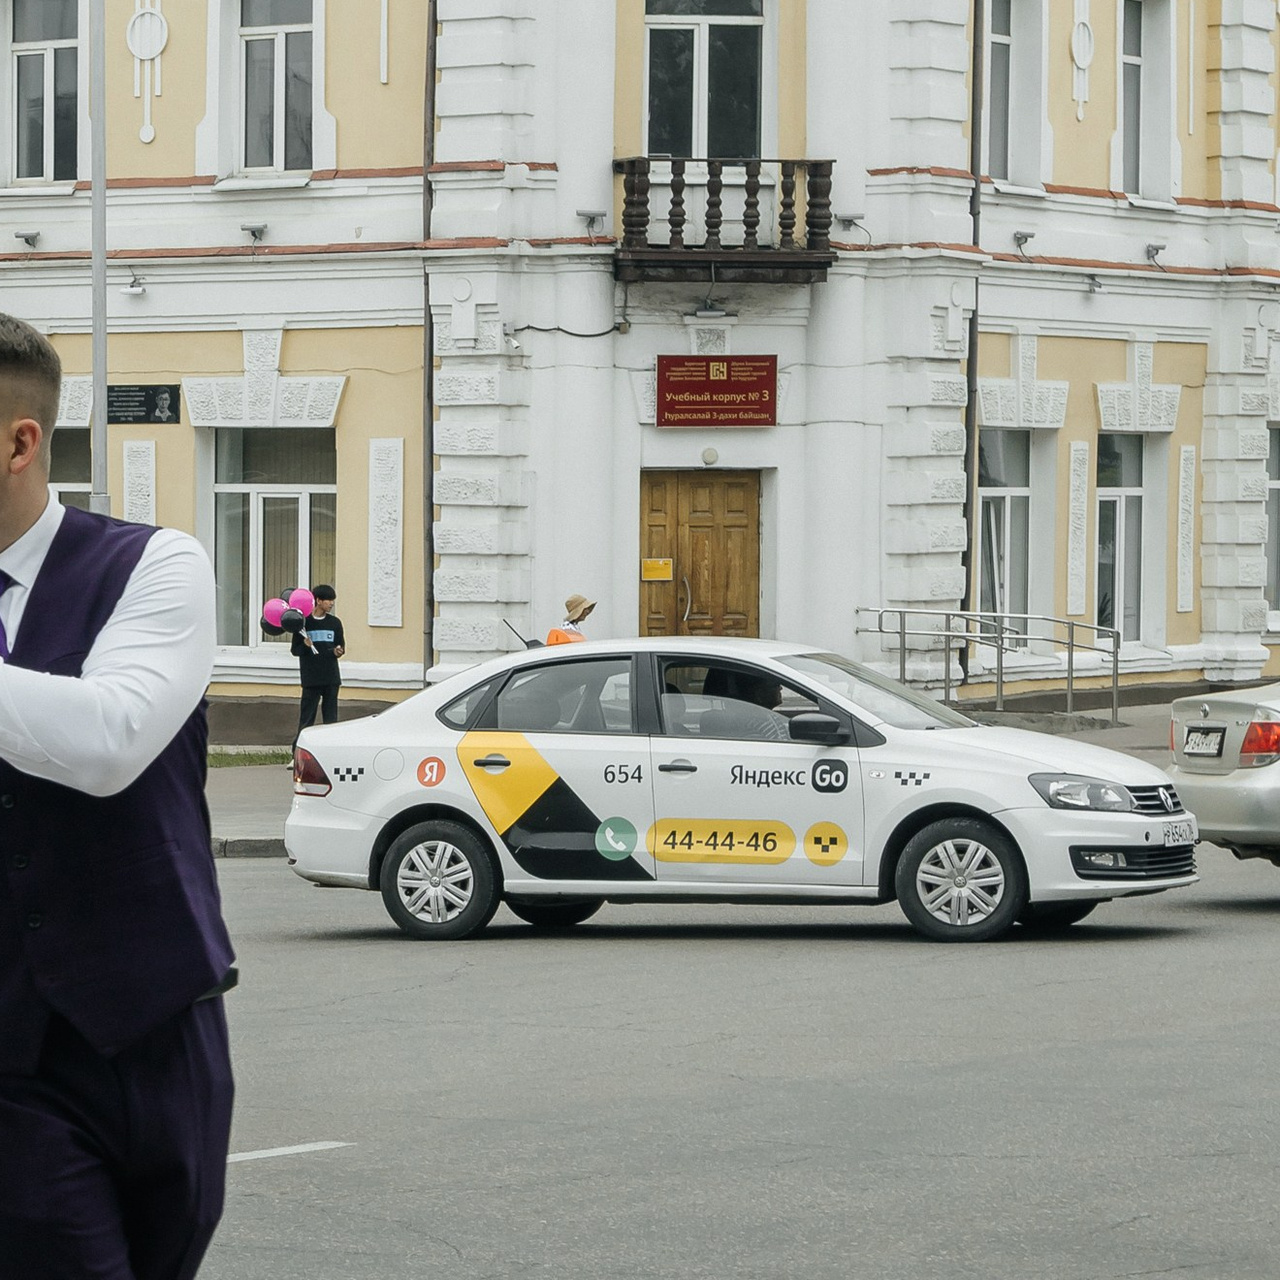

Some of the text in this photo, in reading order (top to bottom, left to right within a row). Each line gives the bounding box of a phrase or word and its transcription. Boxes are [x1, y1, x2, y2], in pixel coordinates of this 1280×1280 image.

[665, 390, 770, 403] Учебный корпус № 3
[712, 412, 738, 421] 3-дахи
[739, 412, 769, 420] байшан
[424, 762, 438, 782] Я
[603, 764, 643, 784] 654
[730, 765, 806, 788] Яндекс
[815, 765, 845, 787] Go
[663, 830, 778, 852] 44-44-46
